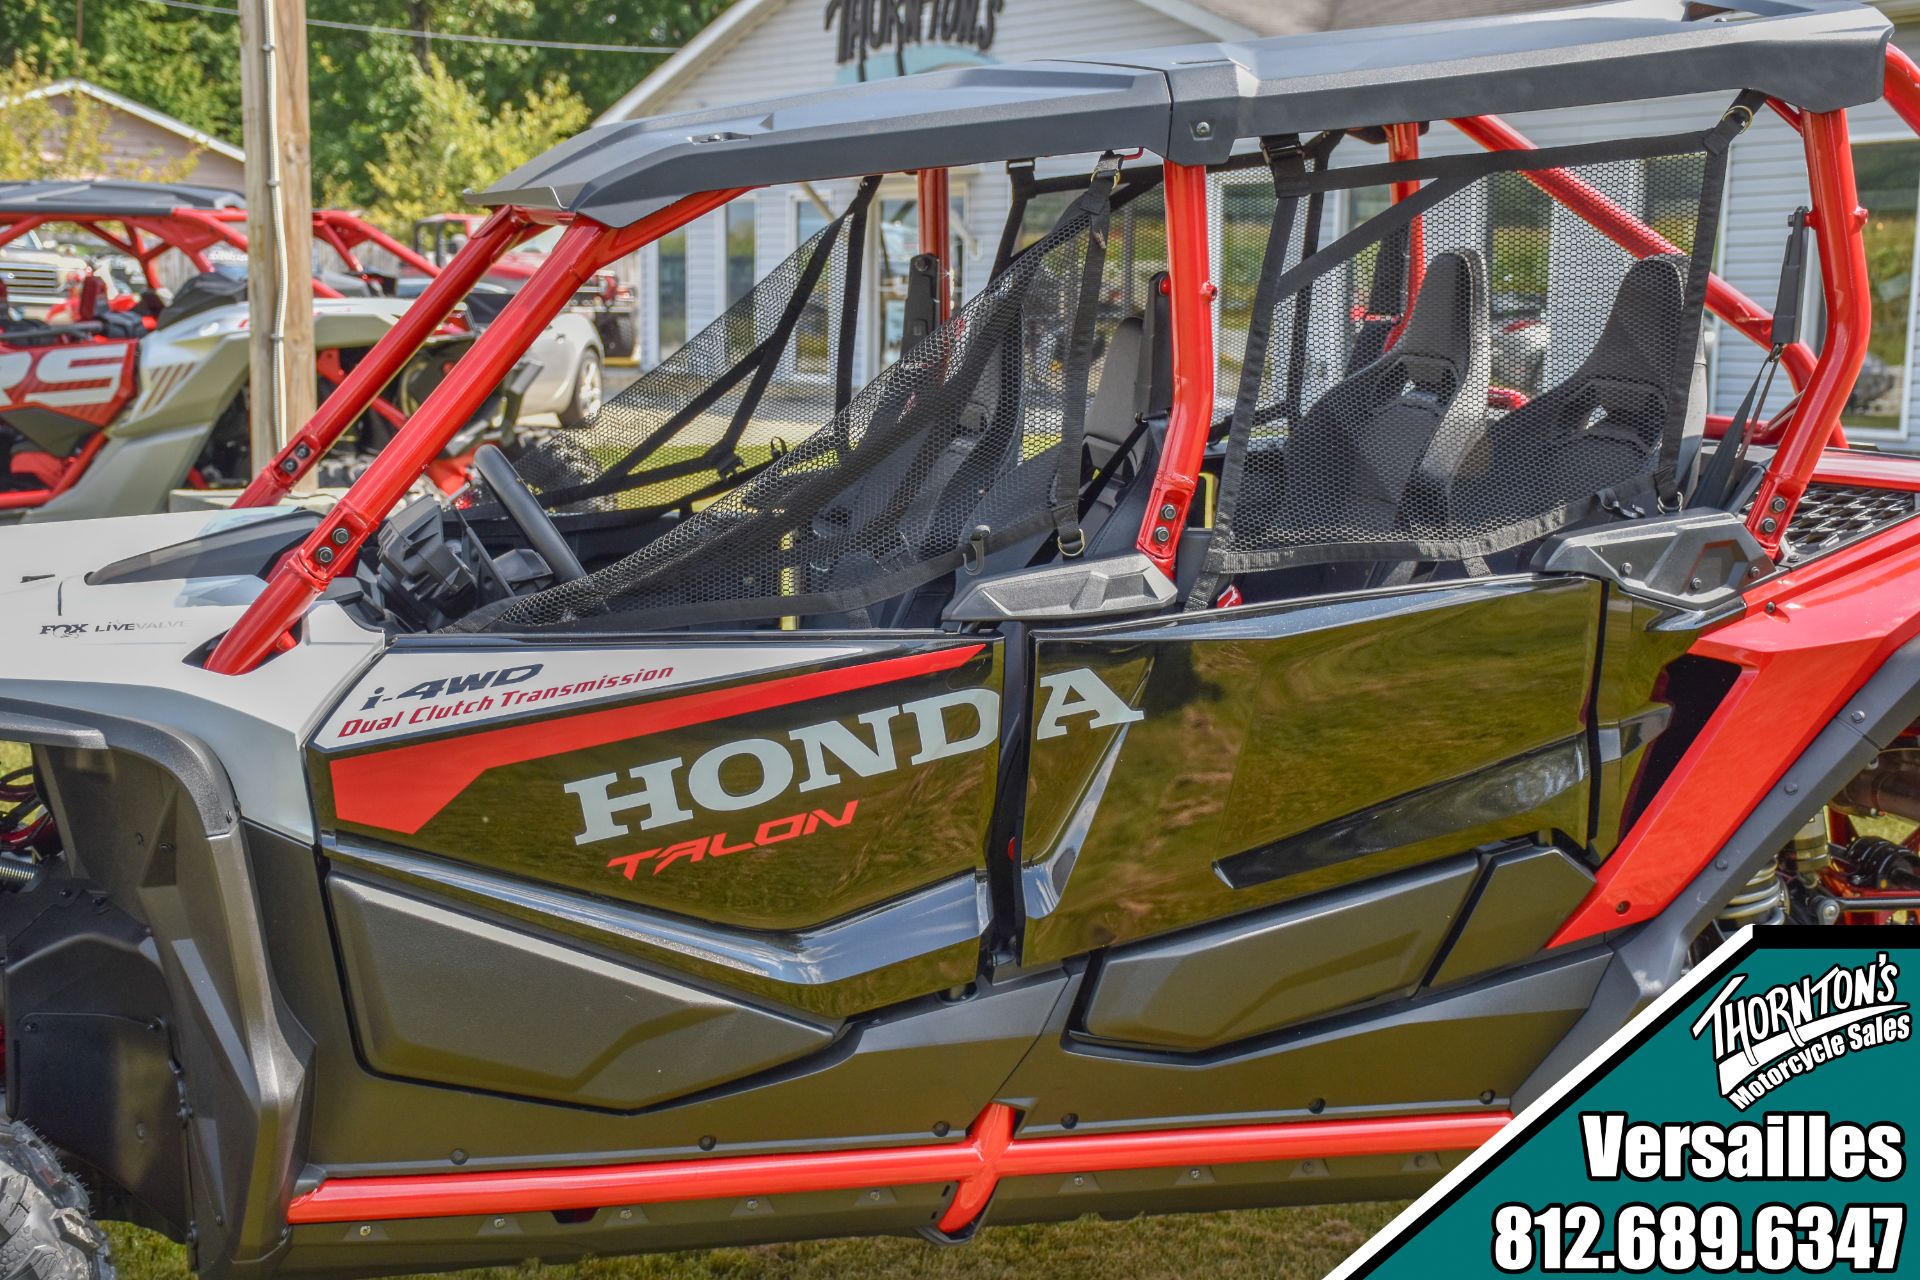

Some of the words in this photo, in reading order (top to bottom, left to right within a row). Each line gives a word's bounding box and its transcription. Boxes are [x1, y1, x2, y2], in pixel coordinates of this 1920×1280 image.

[823, 0, 1004, 82] THORNTONS
[40, 623, 88, 638] FOX
[337, 711, 404, 738] Dual
[408, 696, 494, 725] Clutch
[500, 666, 674, 708] Transmission
[563, 666, 1145, 846] HONDA
[607, 800, 858, 881] TALON
